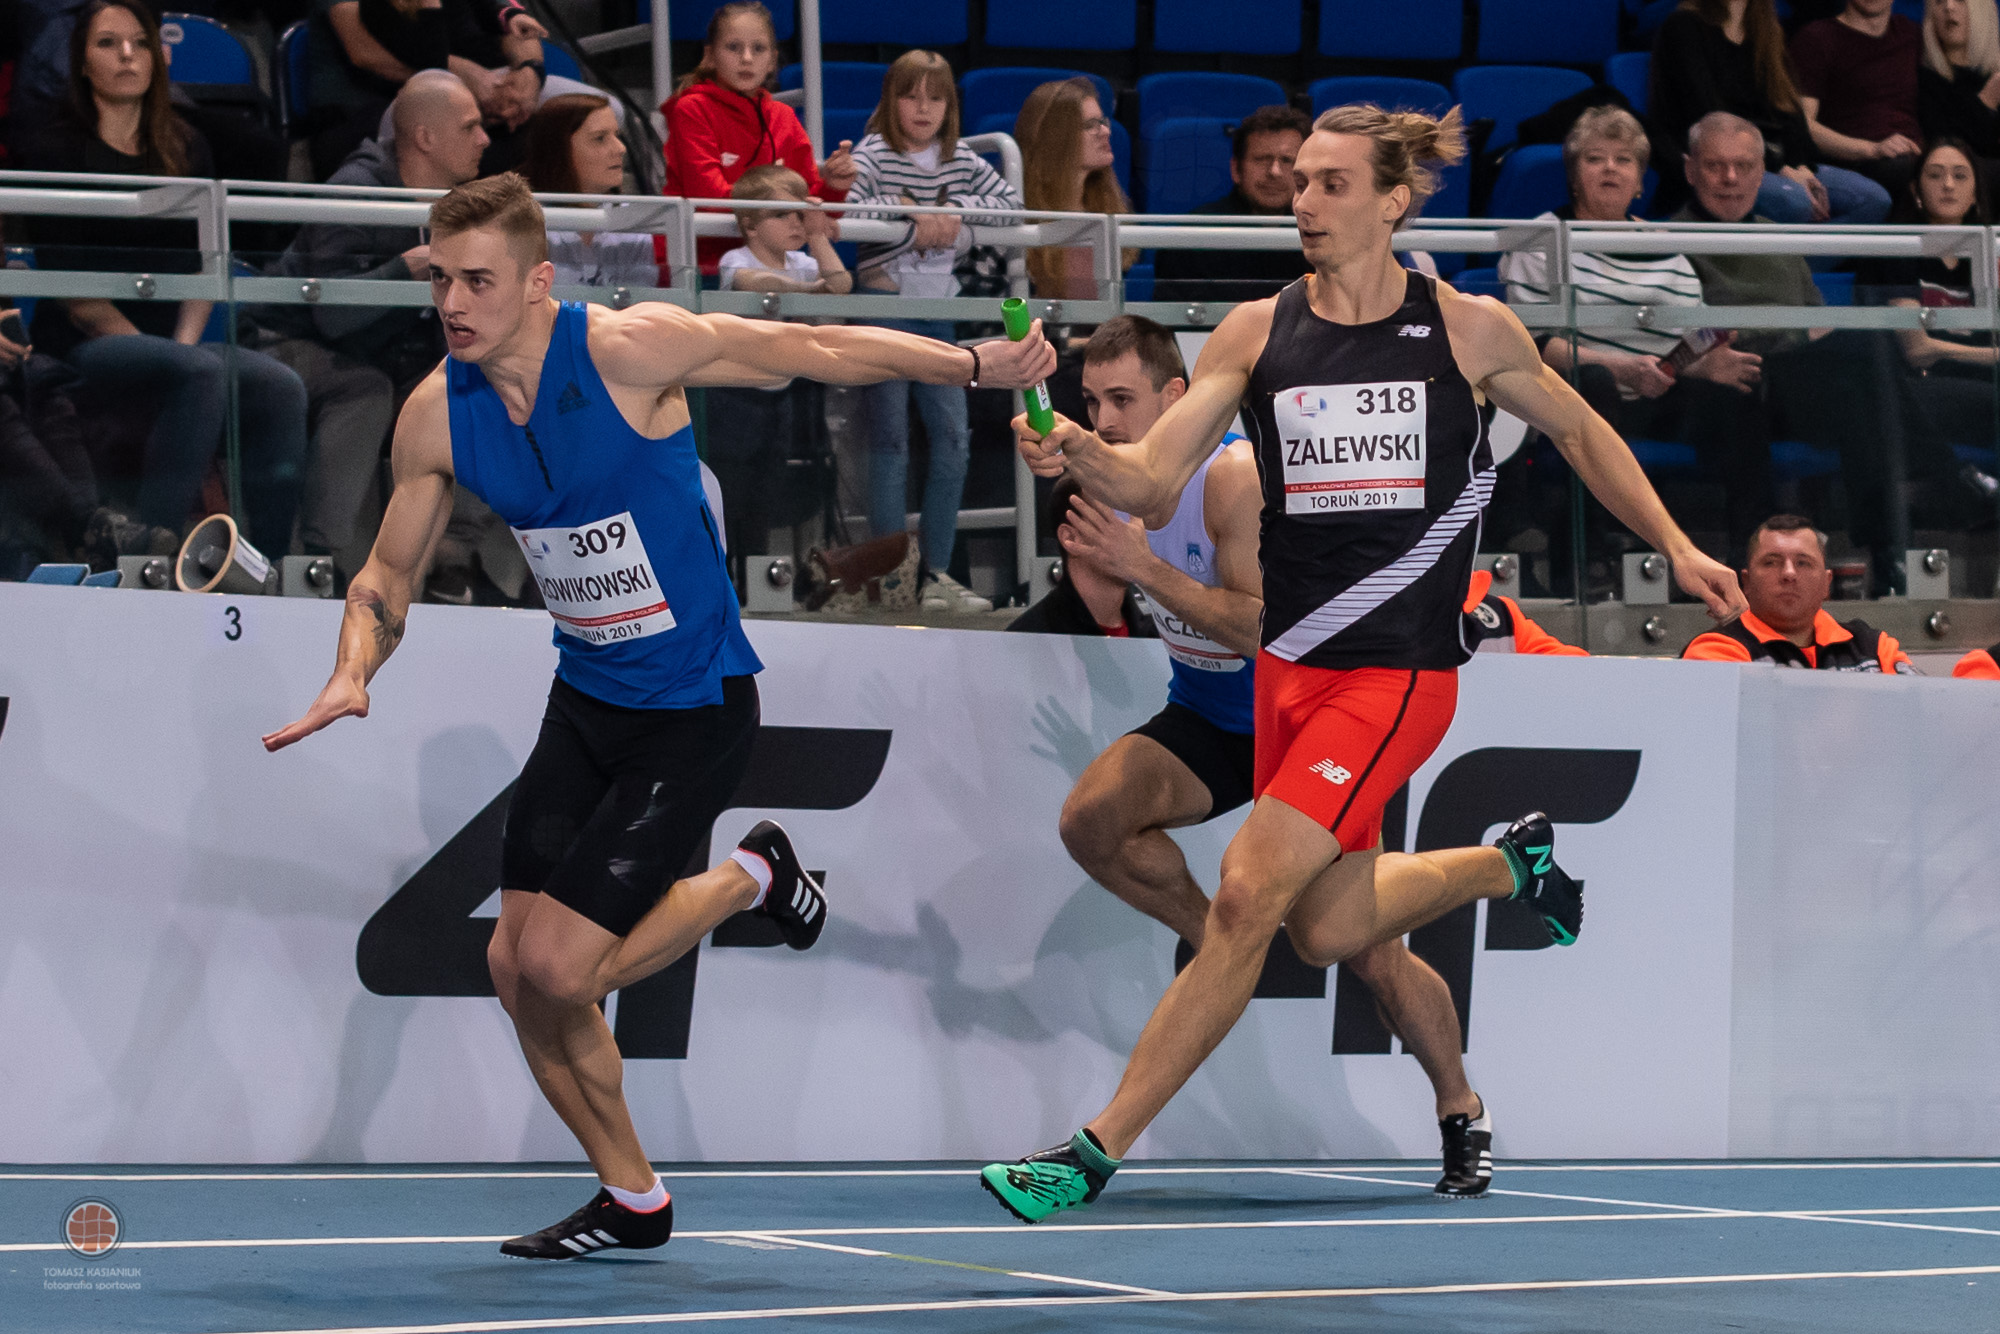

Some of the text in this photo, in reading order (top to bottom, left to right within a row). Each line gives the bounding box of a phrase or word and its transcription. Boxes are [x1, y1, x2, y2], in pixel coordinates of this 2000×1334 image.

[1356, 386, 1417, 415] 318
[1286, 433, 1421, 466] ZALEWSKI
[1346, 480, 1396, 488] MISTRZOSTWA
[1310, 490, 1398, 509] TORUŃ 2019
[568, 521, 627, 558] 309
[224, 605, 242, 641] 3
[609, 622, 642, 640] 2019
[1198, 658, 1222, 670] 2019
